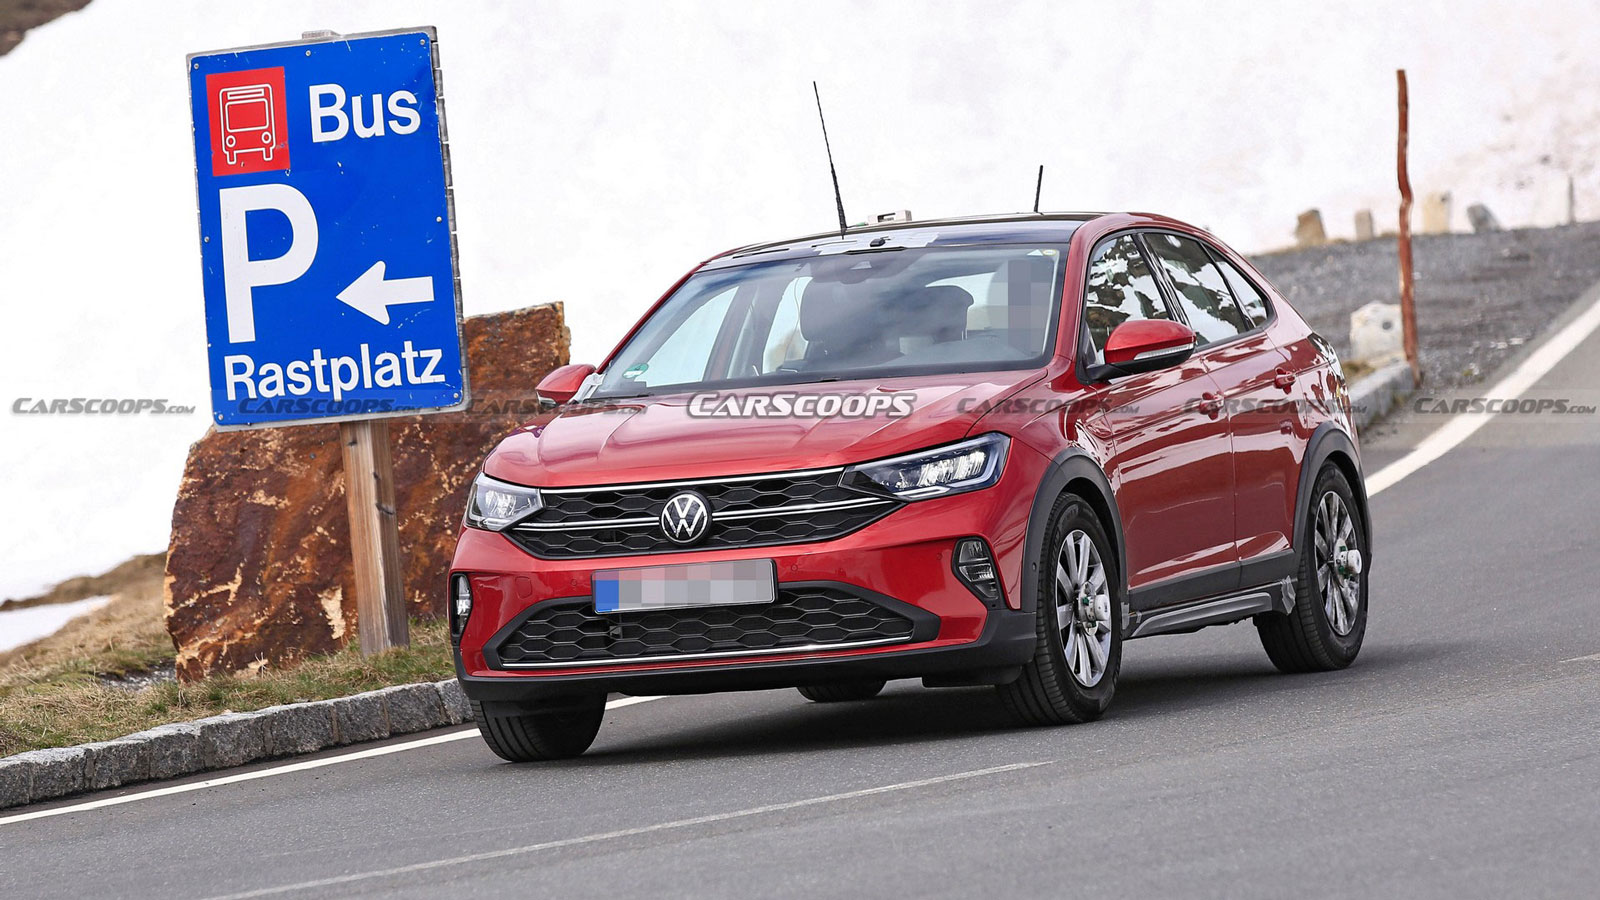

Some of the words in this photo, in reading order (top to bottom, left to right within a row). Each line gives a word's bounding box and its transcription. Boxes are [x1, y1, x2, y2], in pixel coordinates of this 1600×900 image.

[309, 83, 421, 143] Bus
[219, 183, 319, 344] P
[224, 340, 445, 402] Rastplatz
